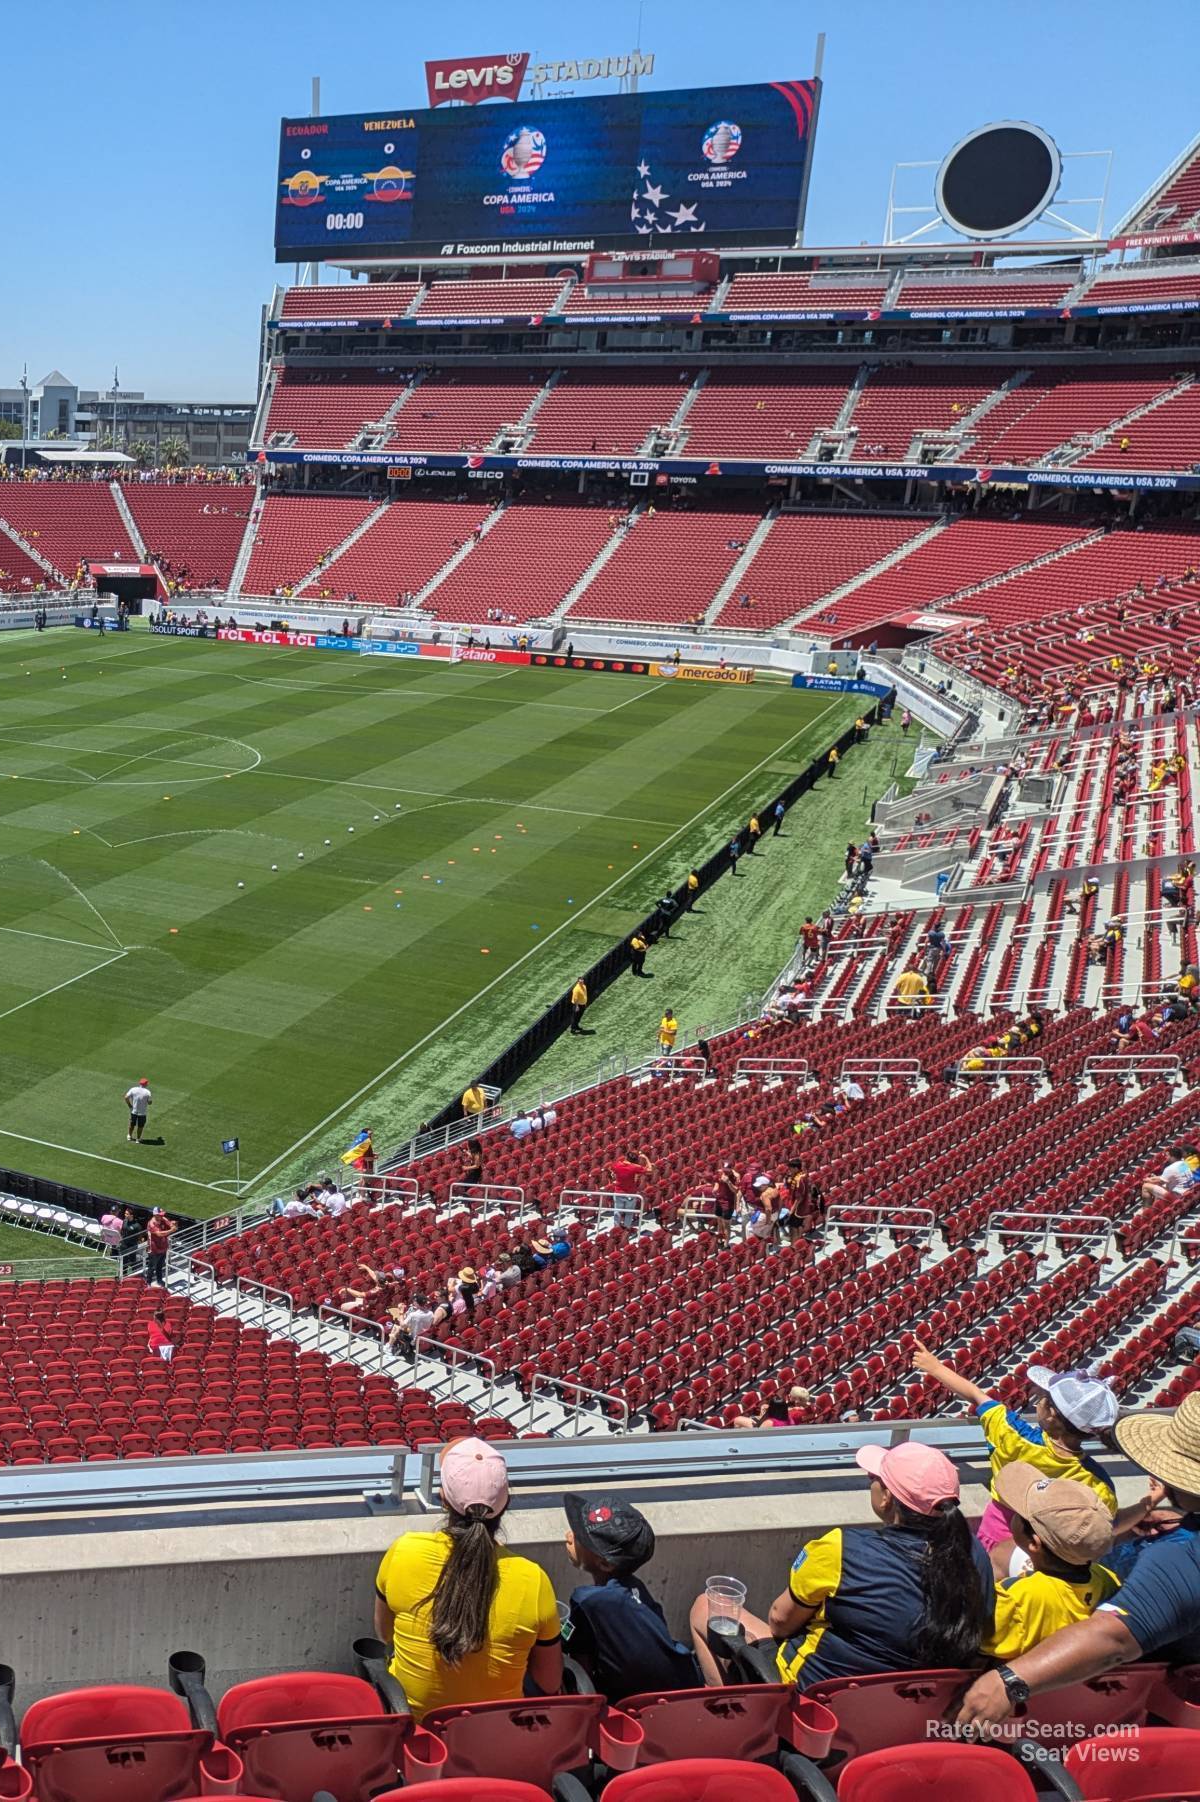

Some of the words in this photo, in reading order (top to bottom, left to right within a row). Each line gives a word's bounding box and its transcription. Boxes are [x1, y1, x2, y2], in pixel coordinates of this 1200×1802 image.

[533, 54, 655, 84] STADIUM
[434, 64, 514, 90] Levi's
[286, 124, 329, 136] ECUADOR
[363, 119, 415, 132] VENEZUELA
[687, 172, 709, 181] COPA
[710, 171, 748, 180] AMERICA
[483, 194, 509, 205] COPA
[510, 192, 555, 204] AMERICA
[326, 212, 364, 230] 00:00
[456, 244, 501, 254] Foxconn
[502, 242, 551, 252] Industrial
[552, 240, 595, 251] Internet
[303, 454, 341, 462] CONMEBOL
[342, 454, 362, 463] COPA
[362, 455, 393, 464] AMERICA
[517, 459, 560, 468] CONMEBOL
[561, 460, 584, 468] COPA
[584, 460, 620, 469] AMERICA
[622, 461, 637, 470] USA
[638, 462, 660, 471] 2024
[468, 471, 504, 479] GEICO
[764, 465, 815, 474] CONMEBOL
[816, 466, 841, 475] COPA
[841, 467, 883, 476] AMERICA
[885, 468, 903, 477] USA
[904, 469, 928, 478] 2024
[1027, 473, 1071, 483] CONMEBOL
[1072, 474, 1094, 484] COPA
[1094, 475, 1134, 486] AMERICA
[1135, 477, 1153, 487] USA
[1154, 478, 1177, 488] 2024
[177, 626, 200, 637] SPORT
[218, 629, 246, 641] TCL
[252, 632, 281, 644] TCL
[287, 634, 316, 647] TCL
[317, 638, 348, 648] BYD
[386, 643, 418, 653] BYD
[682, 667, 737, 681] mercado
